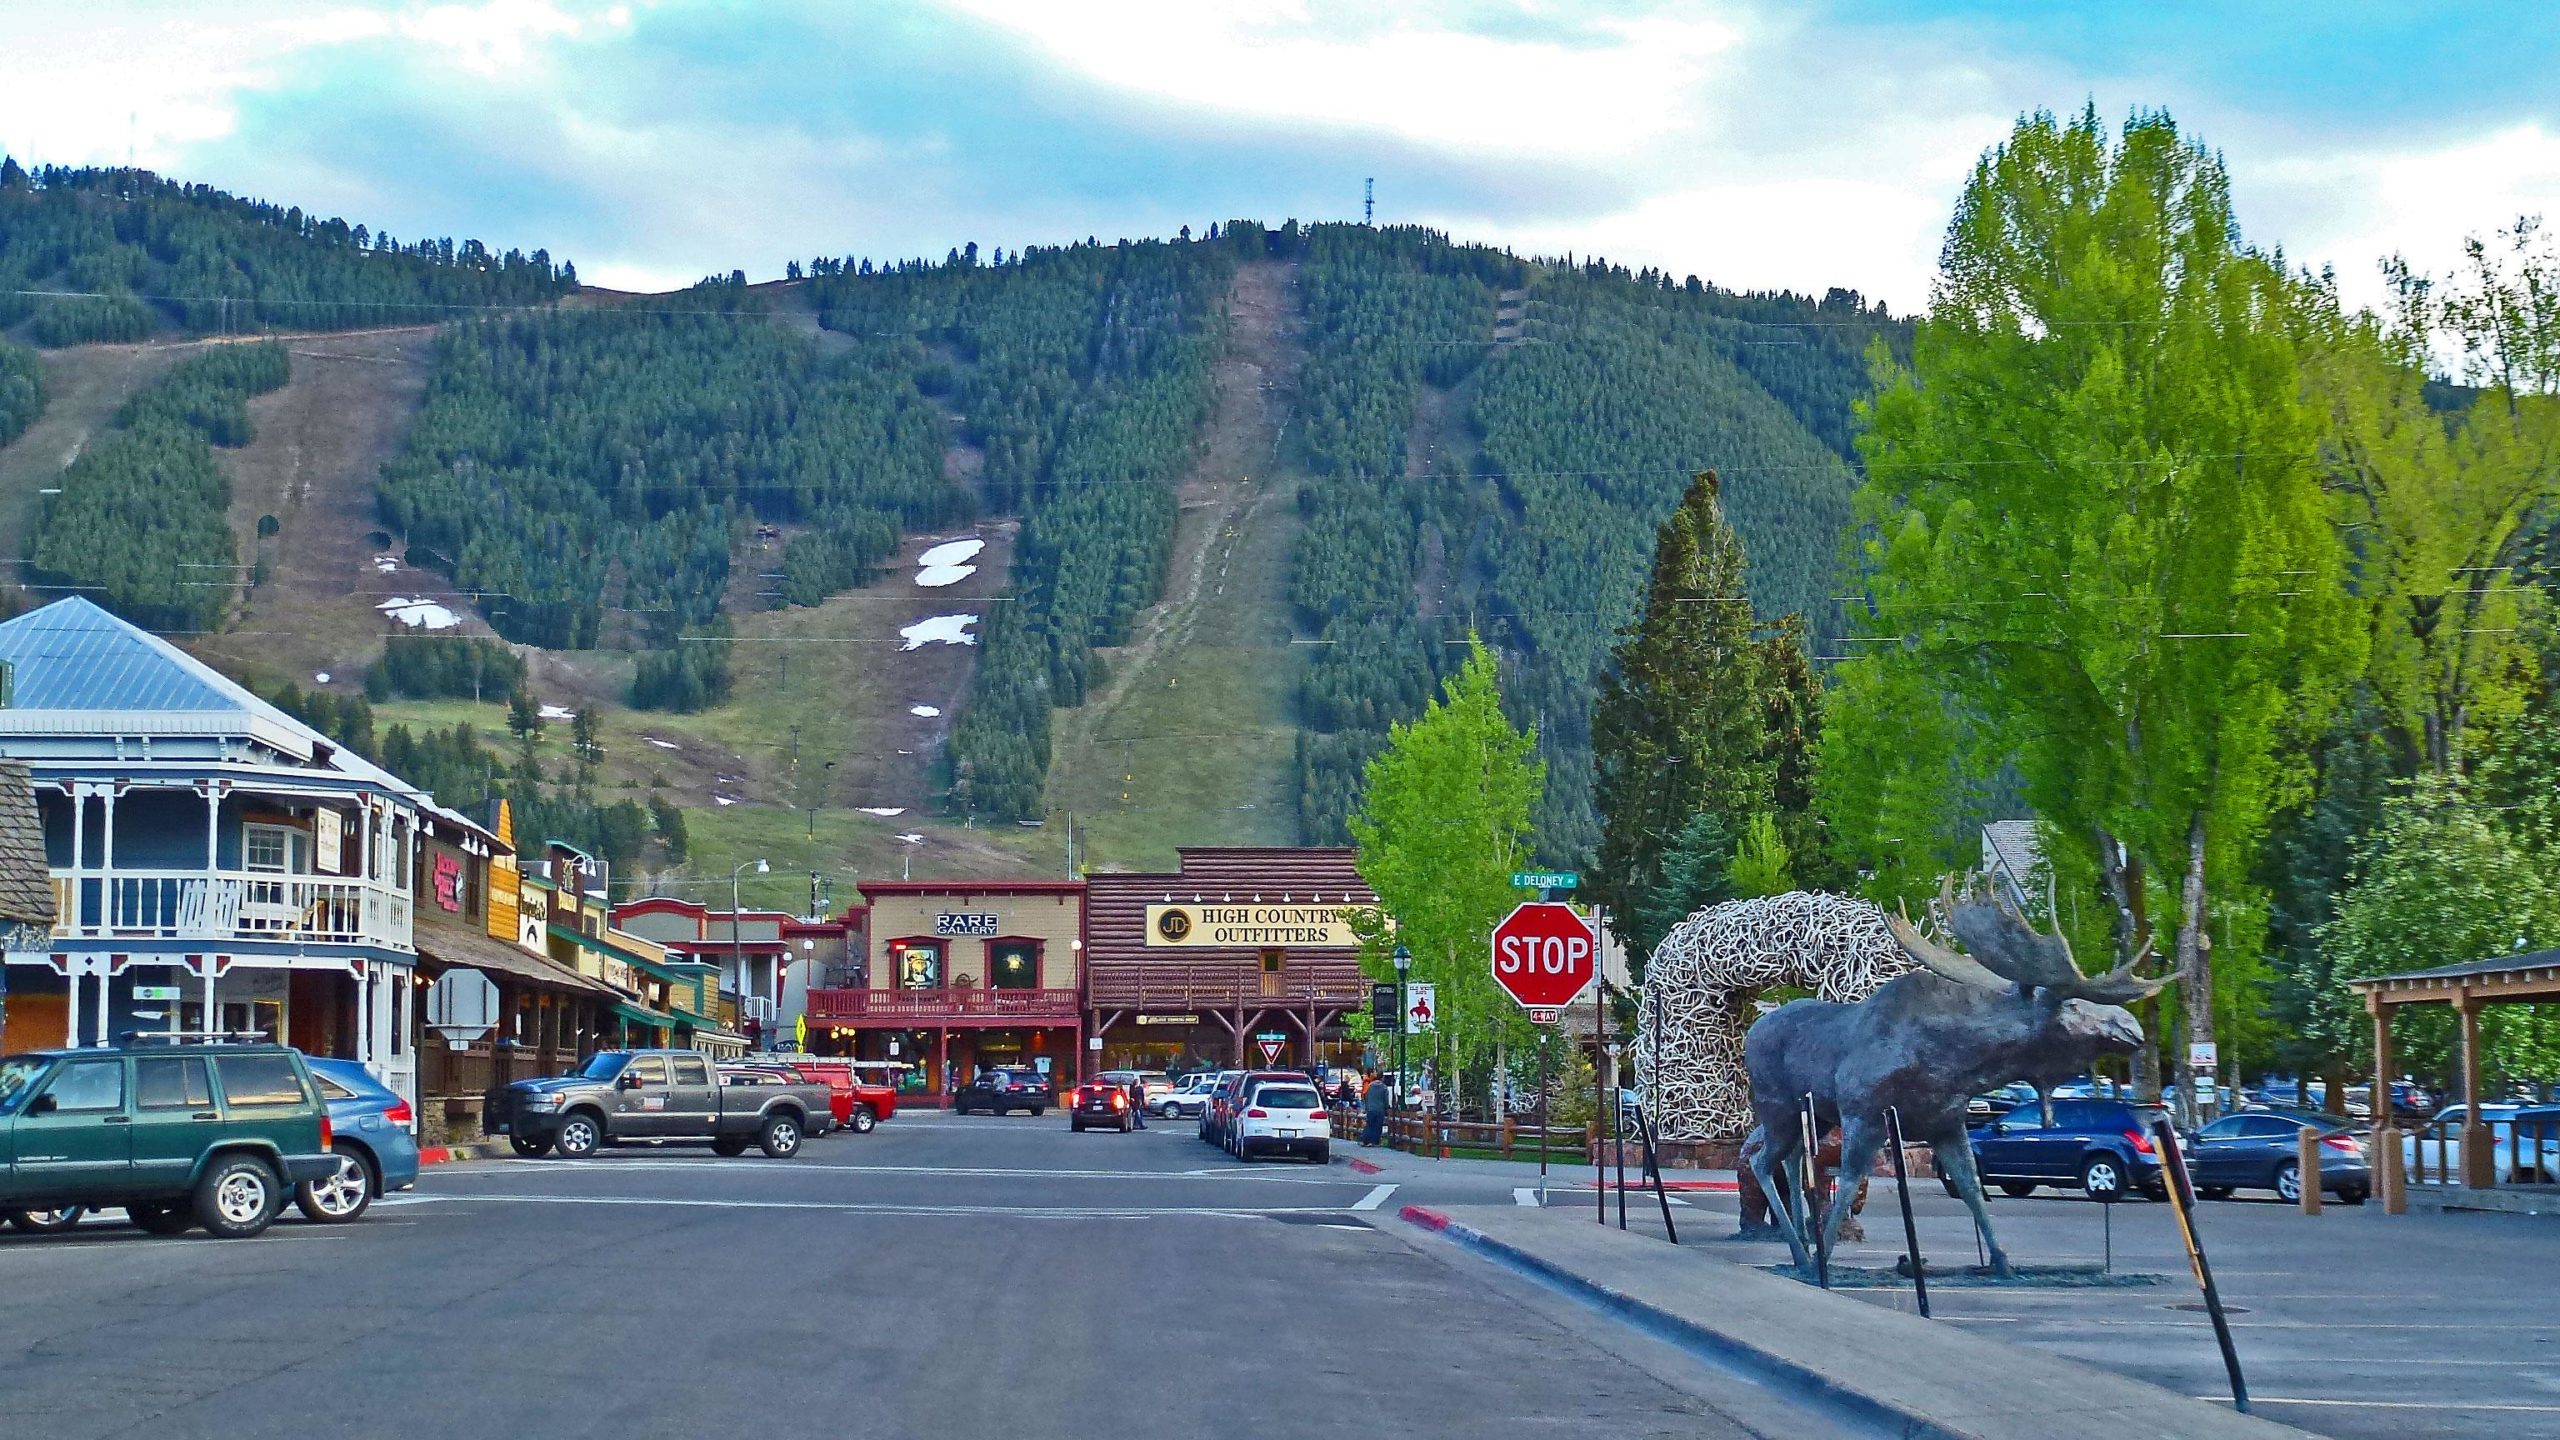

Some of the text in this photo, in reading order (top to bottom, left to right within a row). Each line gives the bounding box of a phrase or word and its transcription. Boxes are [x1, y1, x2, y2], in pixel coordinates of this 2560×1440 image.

[1514, 876, 1521, 886] E
[1523, 875, 1564, 887] DELONEY
[937, 914, 998, 927] RARE
[1201, 908, 1339, 924] HIGH COUNTRY
[937, 926, 997, 935] GALLERY
[1214, 927, 1329, 943] OUTFITTERS
[1499, 935, 1589, 975] STOP
[1532, 1011, 1556, 1021] 4-WAY
